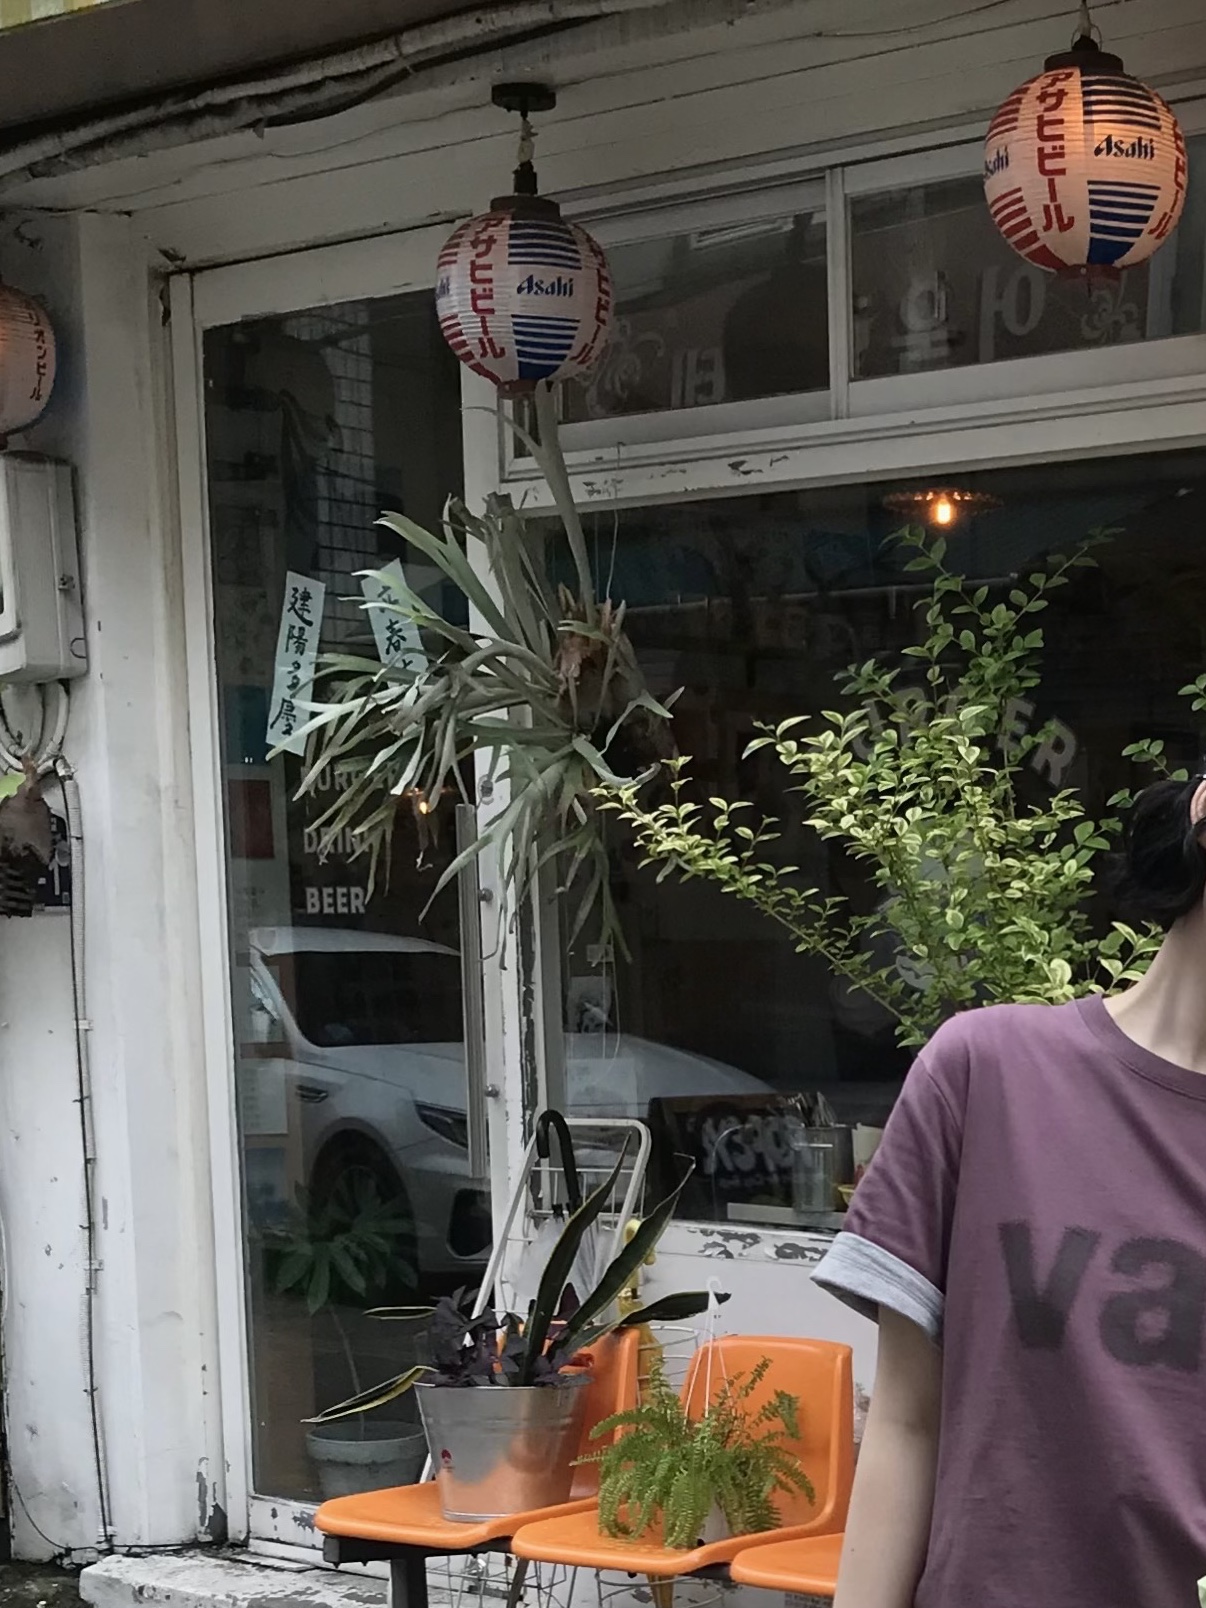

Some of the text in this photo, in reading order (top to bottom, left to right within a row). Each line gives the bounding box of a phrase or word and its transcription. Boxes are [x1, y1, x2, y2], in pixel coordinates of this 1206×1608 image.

[1035, 71, 1075, 233] アサヒビール
[1093, 134, 1155, 161] Asahi
[469, 217, 506, 359] アサヒビール
[516, 274, 574, 298] Asahi
[305, 886, 366, 915] BEER
